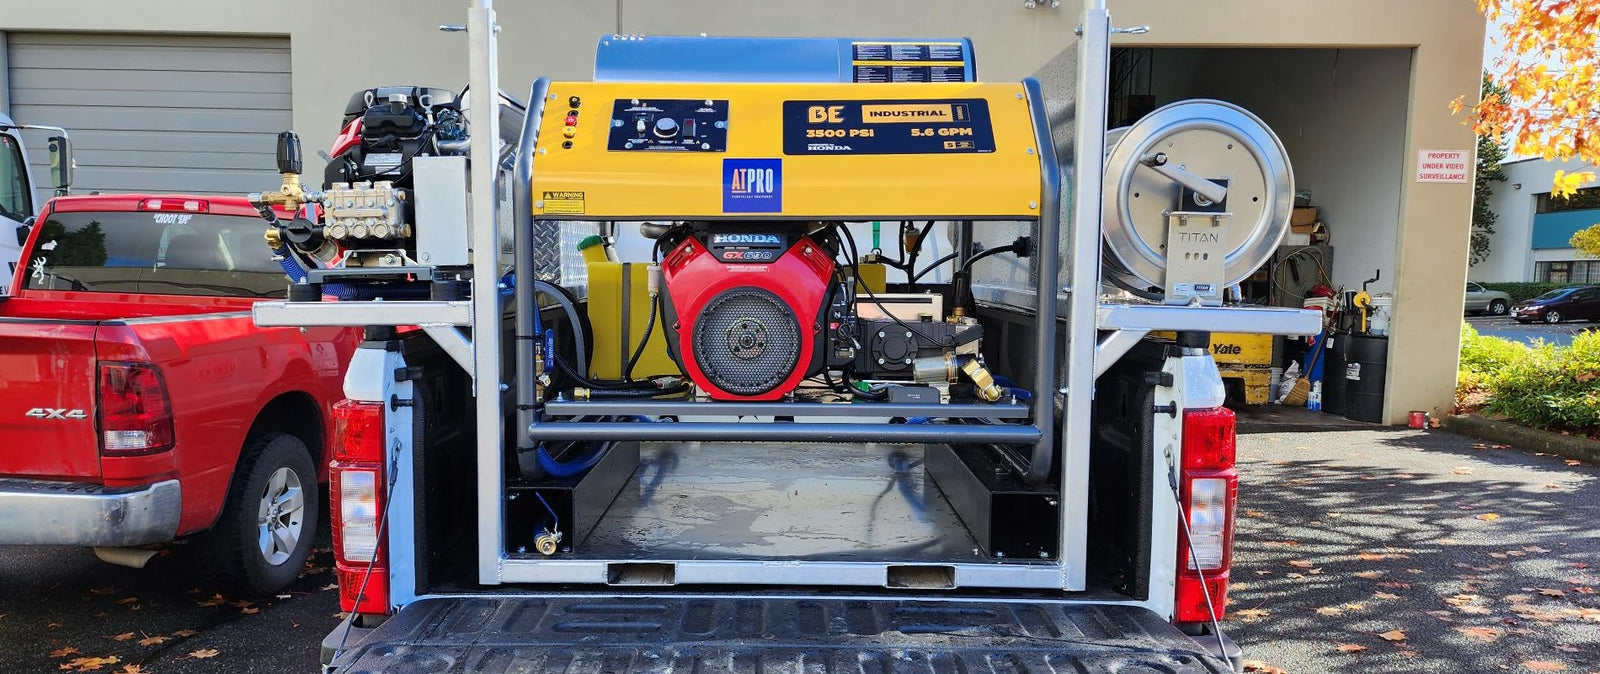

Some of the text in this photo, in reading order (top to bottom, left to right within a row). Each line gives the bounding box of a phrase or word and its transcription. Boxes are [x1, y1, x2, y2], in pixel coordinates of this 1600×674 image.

[808, 105, 847, 123] BE
[805, 128, 875, 138] 3500 PSI
[910, 127, 973, 137] 5.6 GPM
[714, 234, 780, 243] HONDA
[1178, 232, 1219, 243] TITAN
[1213, 343, 1242, 355] Yale
[25, 408, 88, 420] 4X4
